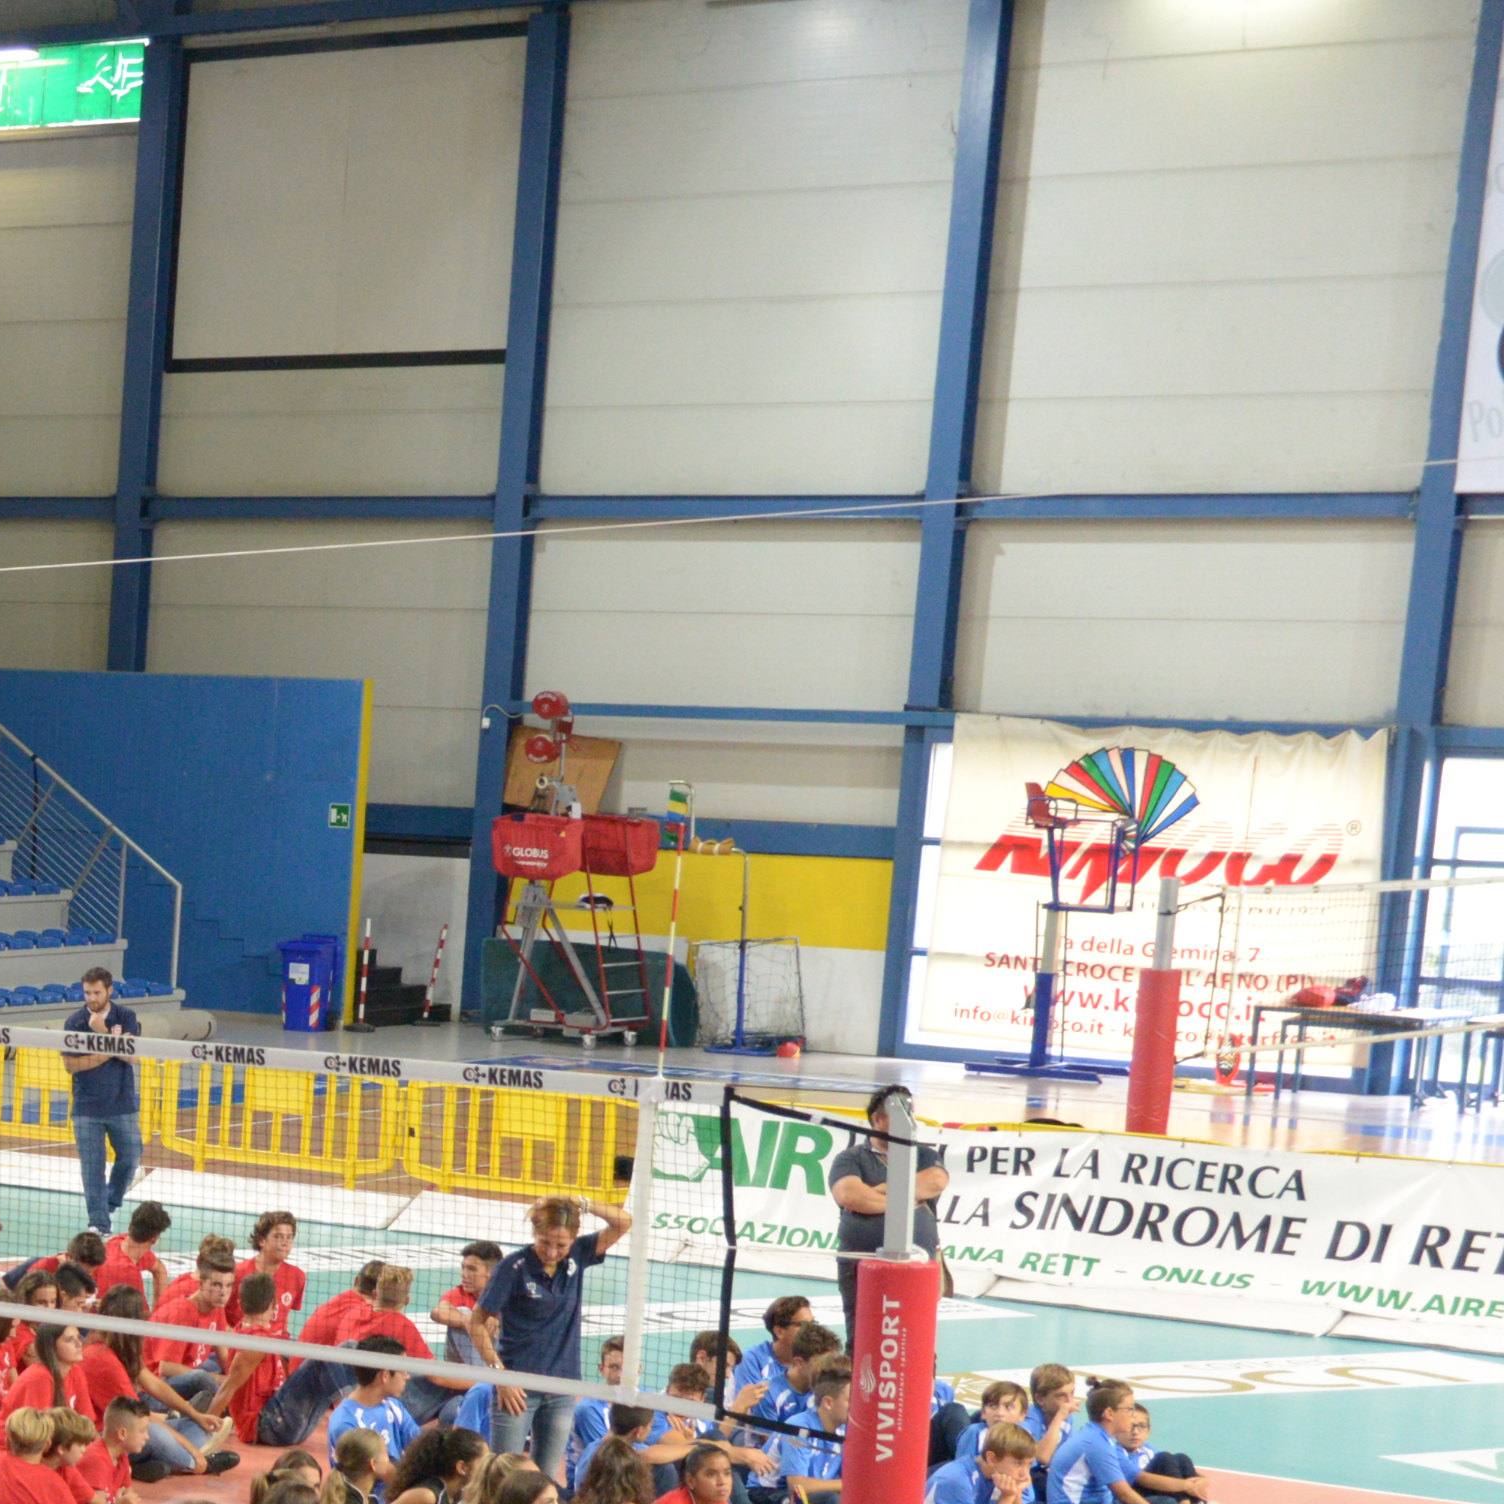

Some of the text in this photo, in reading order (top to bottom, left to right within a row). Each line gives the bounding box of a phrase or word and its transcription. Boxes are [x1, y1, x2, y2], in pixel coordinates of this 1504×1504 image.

[512, 846, 549, 860] GLOBUS
[1080, 935, 1134, 956] della
[1248, 946, 1261, 963] 7
[984, 950, 1043, 973] SANT
[1063, 959, 1135, 983] CROCE
[953, 1003, 1105, 1037] info@kioco.it
[86, 1035, 135, 1056] KEMAS
[214, 1045, 266, 1066] KEMAS
[348, 1055, 402, 1077] KEMAS
[488, 1067, 543, 1090] KEMAS
[967, 1144, 1037, 1179] PER
[1052, 1147, 1102, 1180] LA
[1120, 1152, 1308, 1202] RICERCA
[1008, 1190, 1309, 1258] SINDROME
[1324, 1219, 1394, 1264] DI
[1017, 1251, 1102, 1278] RETT
[1140, 1264, 1256, 1290] ONLUS
[875, 1293, 901, 1463] VIVISPORT
